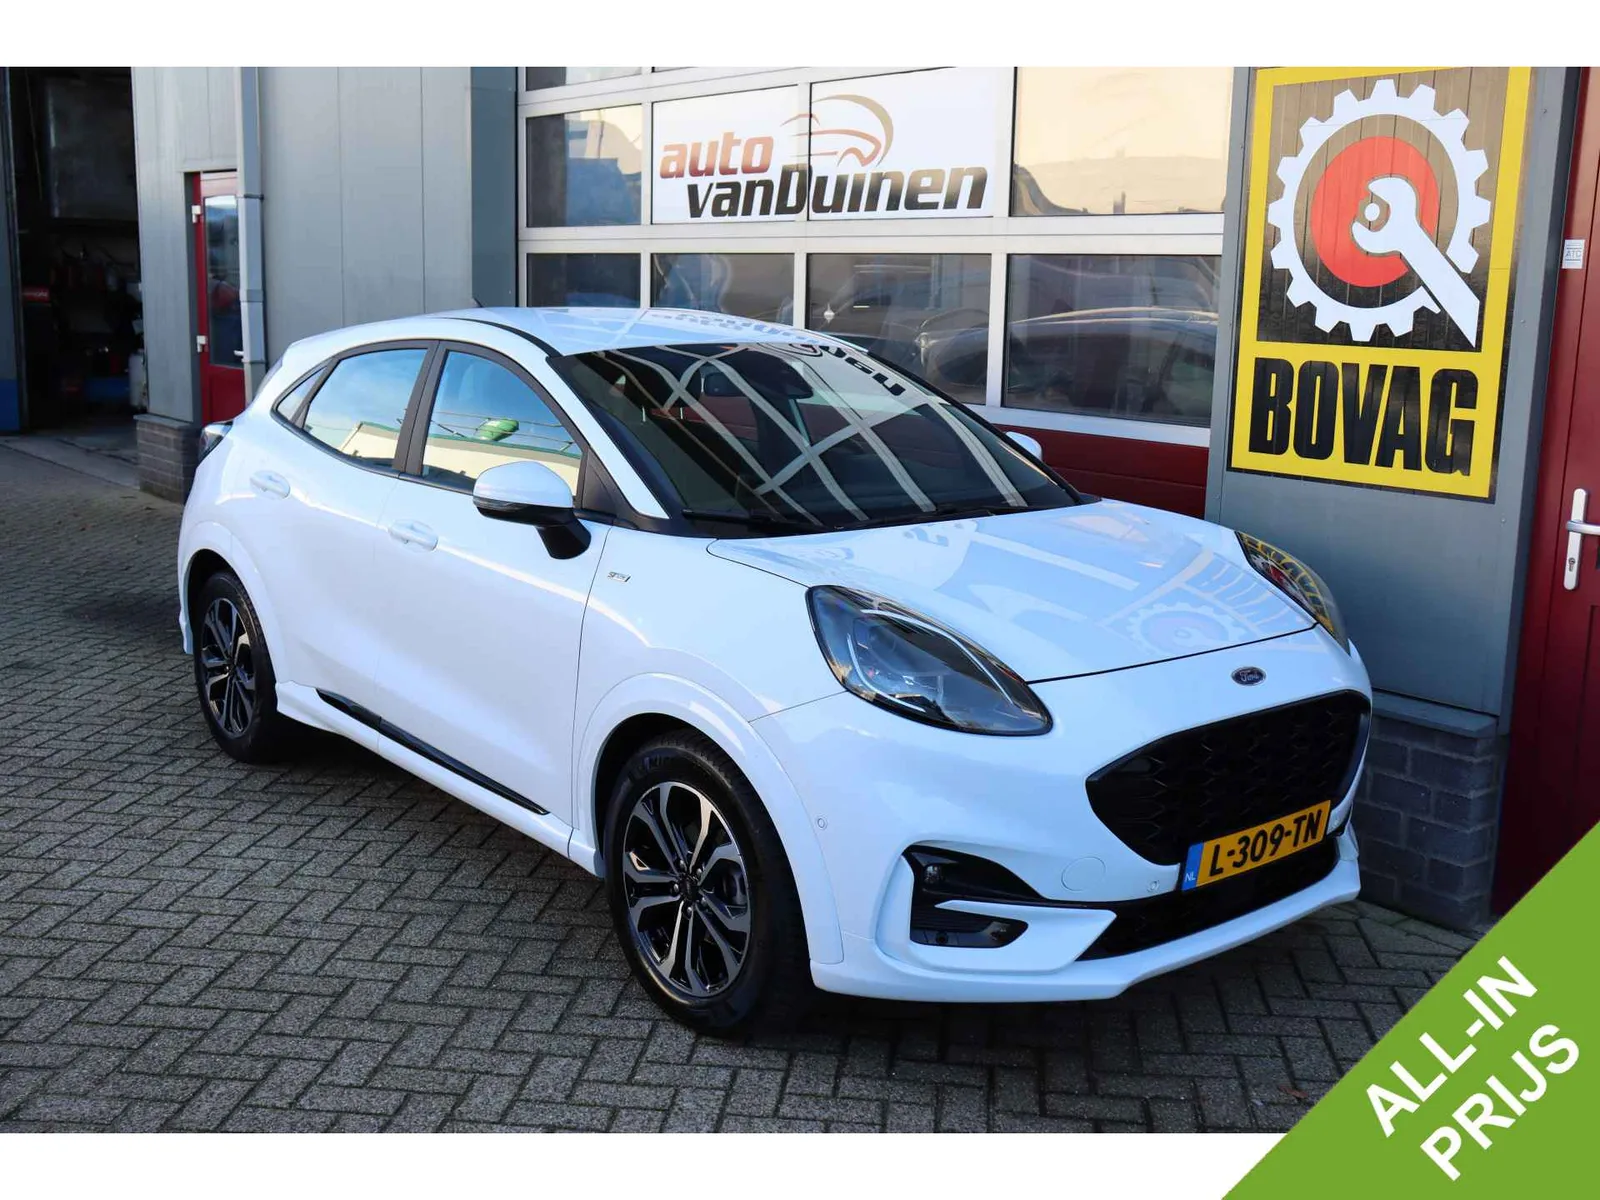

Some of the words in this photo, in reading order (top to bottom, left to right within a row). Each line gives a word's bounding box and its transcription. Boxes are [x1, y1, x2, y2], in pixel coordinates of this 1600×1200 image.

[659, 132, 774, 179] auto
[687, 163, 988, 219] vanDuinen
[1248, 357, 1479, 476] BOVAG
[1209, 809, 1322, 877] L-309-TN
[1184, 871, 1197, 883] NL
